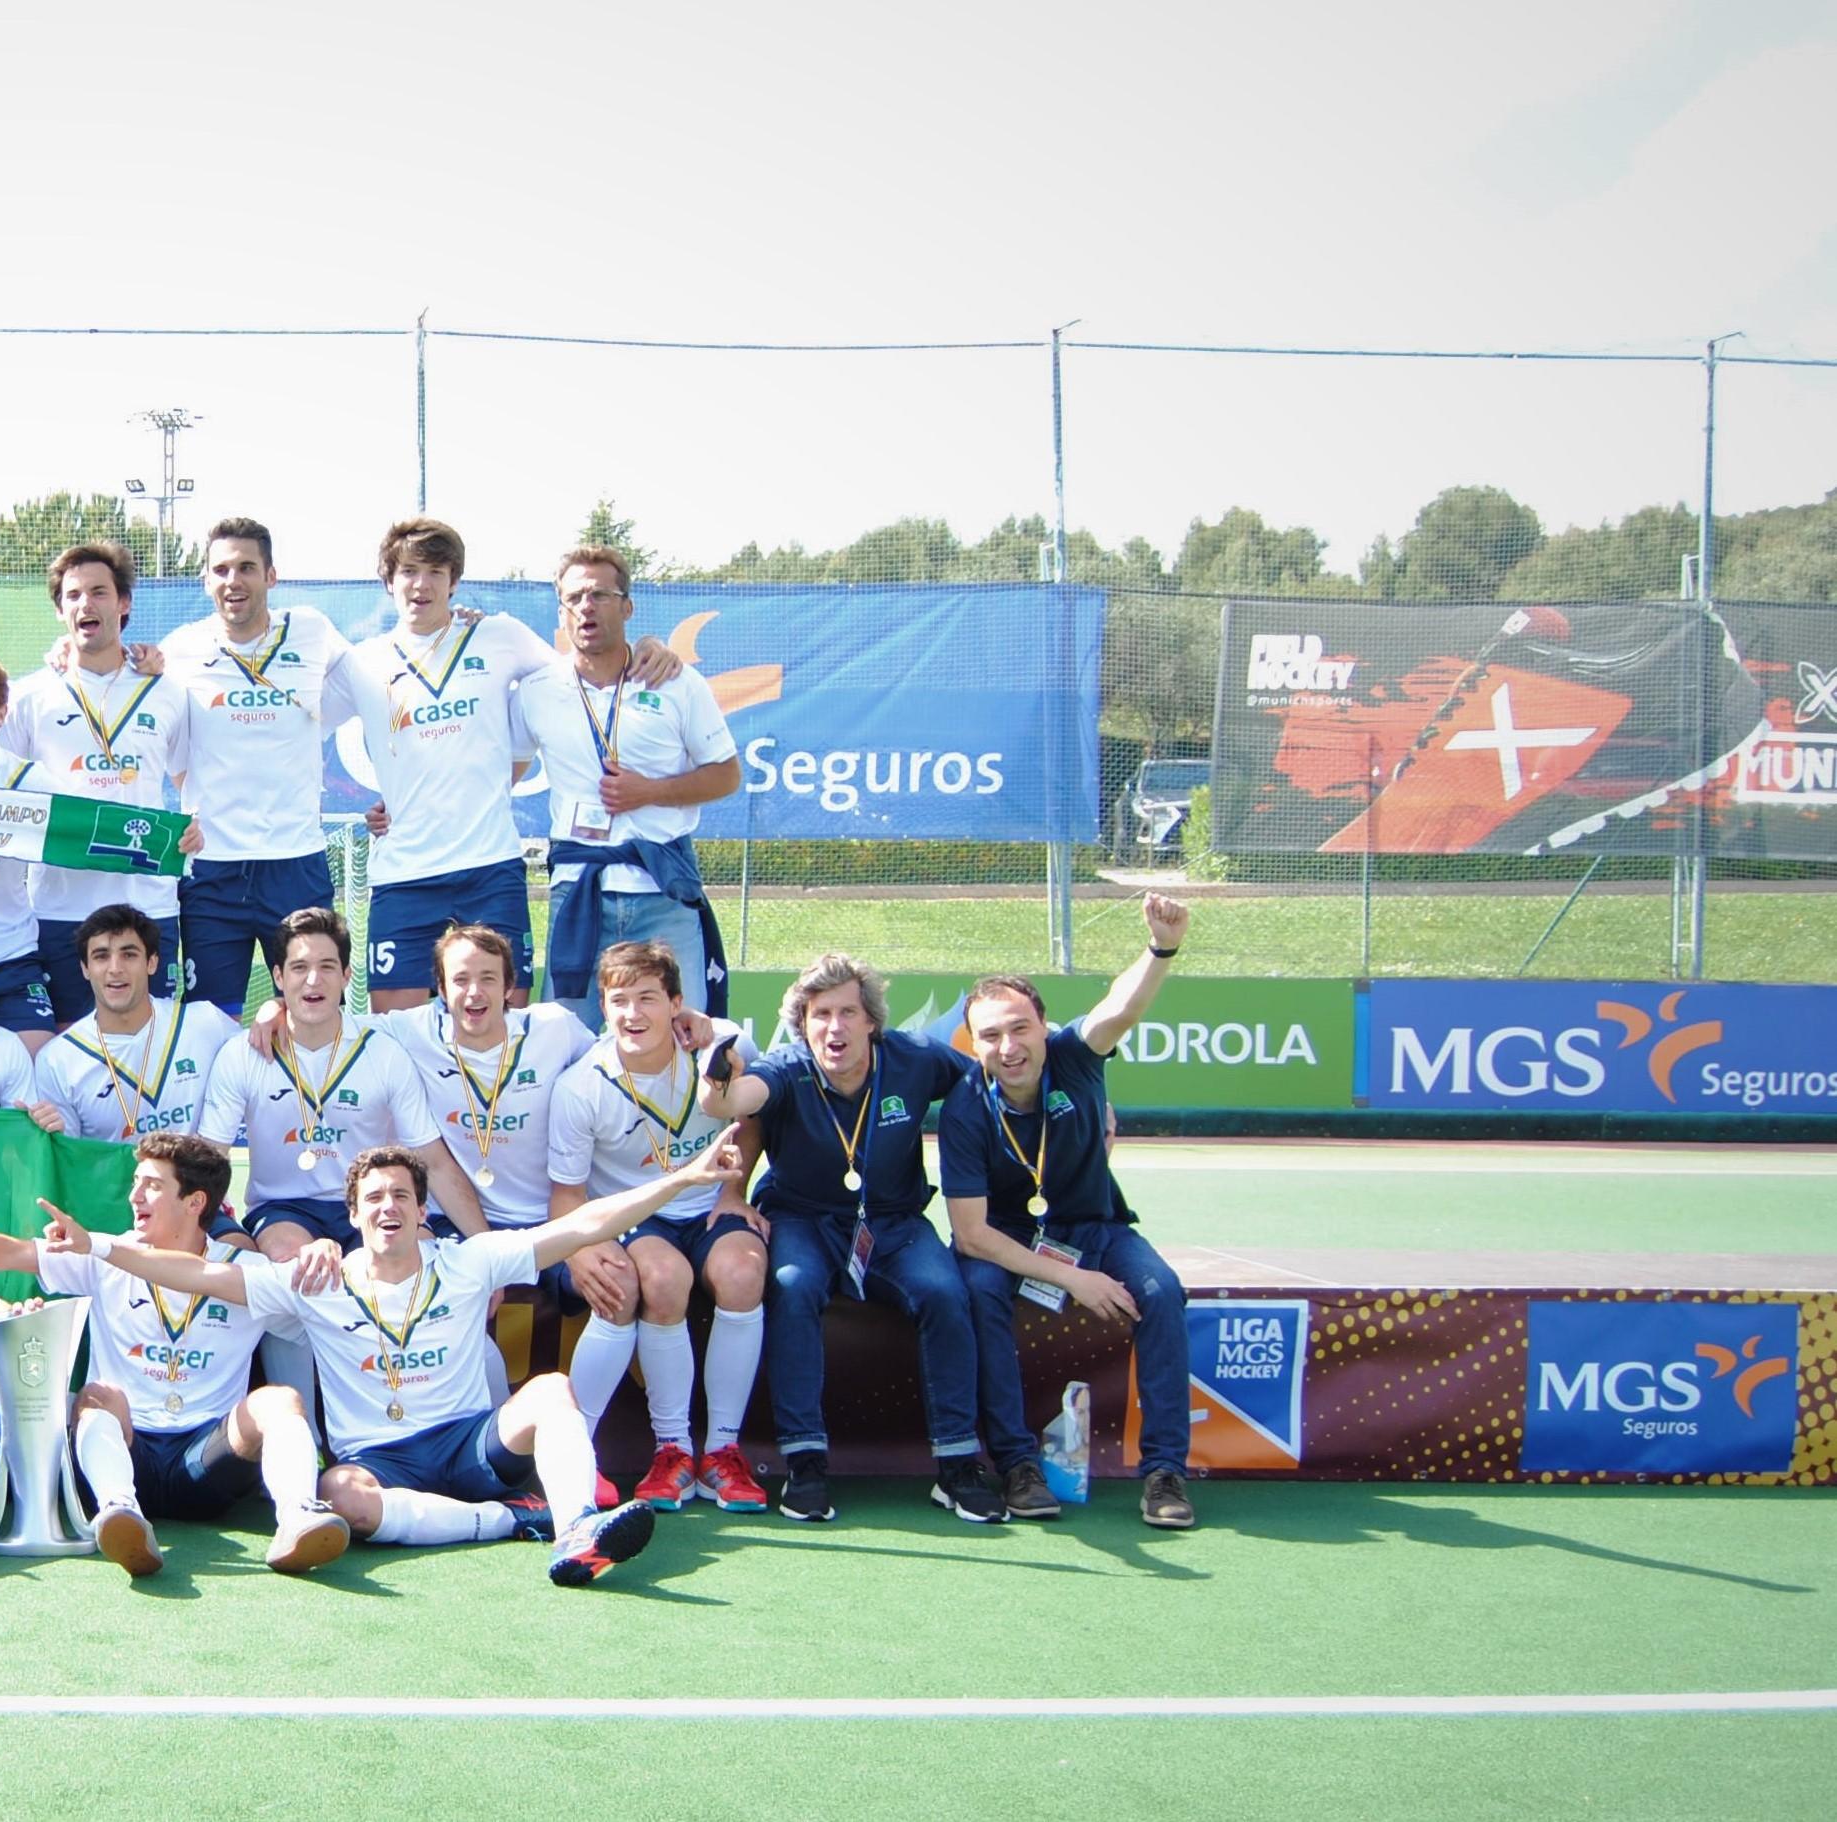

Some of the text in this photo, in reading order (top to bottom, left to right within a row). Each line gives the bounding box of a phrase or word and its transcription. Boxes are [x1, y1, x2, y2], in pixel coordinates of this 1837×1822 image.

[228, 688, 296, 707] caser
[230, 711, 276, 724] seguros
[413, 697, 479, 724] caser
[419, 724, 461, 740] seguros
[87, 754, 142, 771] caser
[1740, 746, 1837, 790] MUN
[745, 738, 1003, 812] Seguros
[369, 941, 395, 974] 15
[1390, 1026, 1605, 1096] MGS
[137, 1104, 193, 1134] caser
[456, 1112, 529, 1130] caser
[1219, 1318, 1284, 1341] LIGA
[146, 1345, 214, 1369] caser
[378, 1346, 448, 1371] caser
[1218, 1343, 1284, 1364] MGS
[1216, 1365, 1282, 1379] HOCKEY
[1537, 1361, 1701, 1412] MGS
[1622, 1418, 1697, 1437] Seguros
